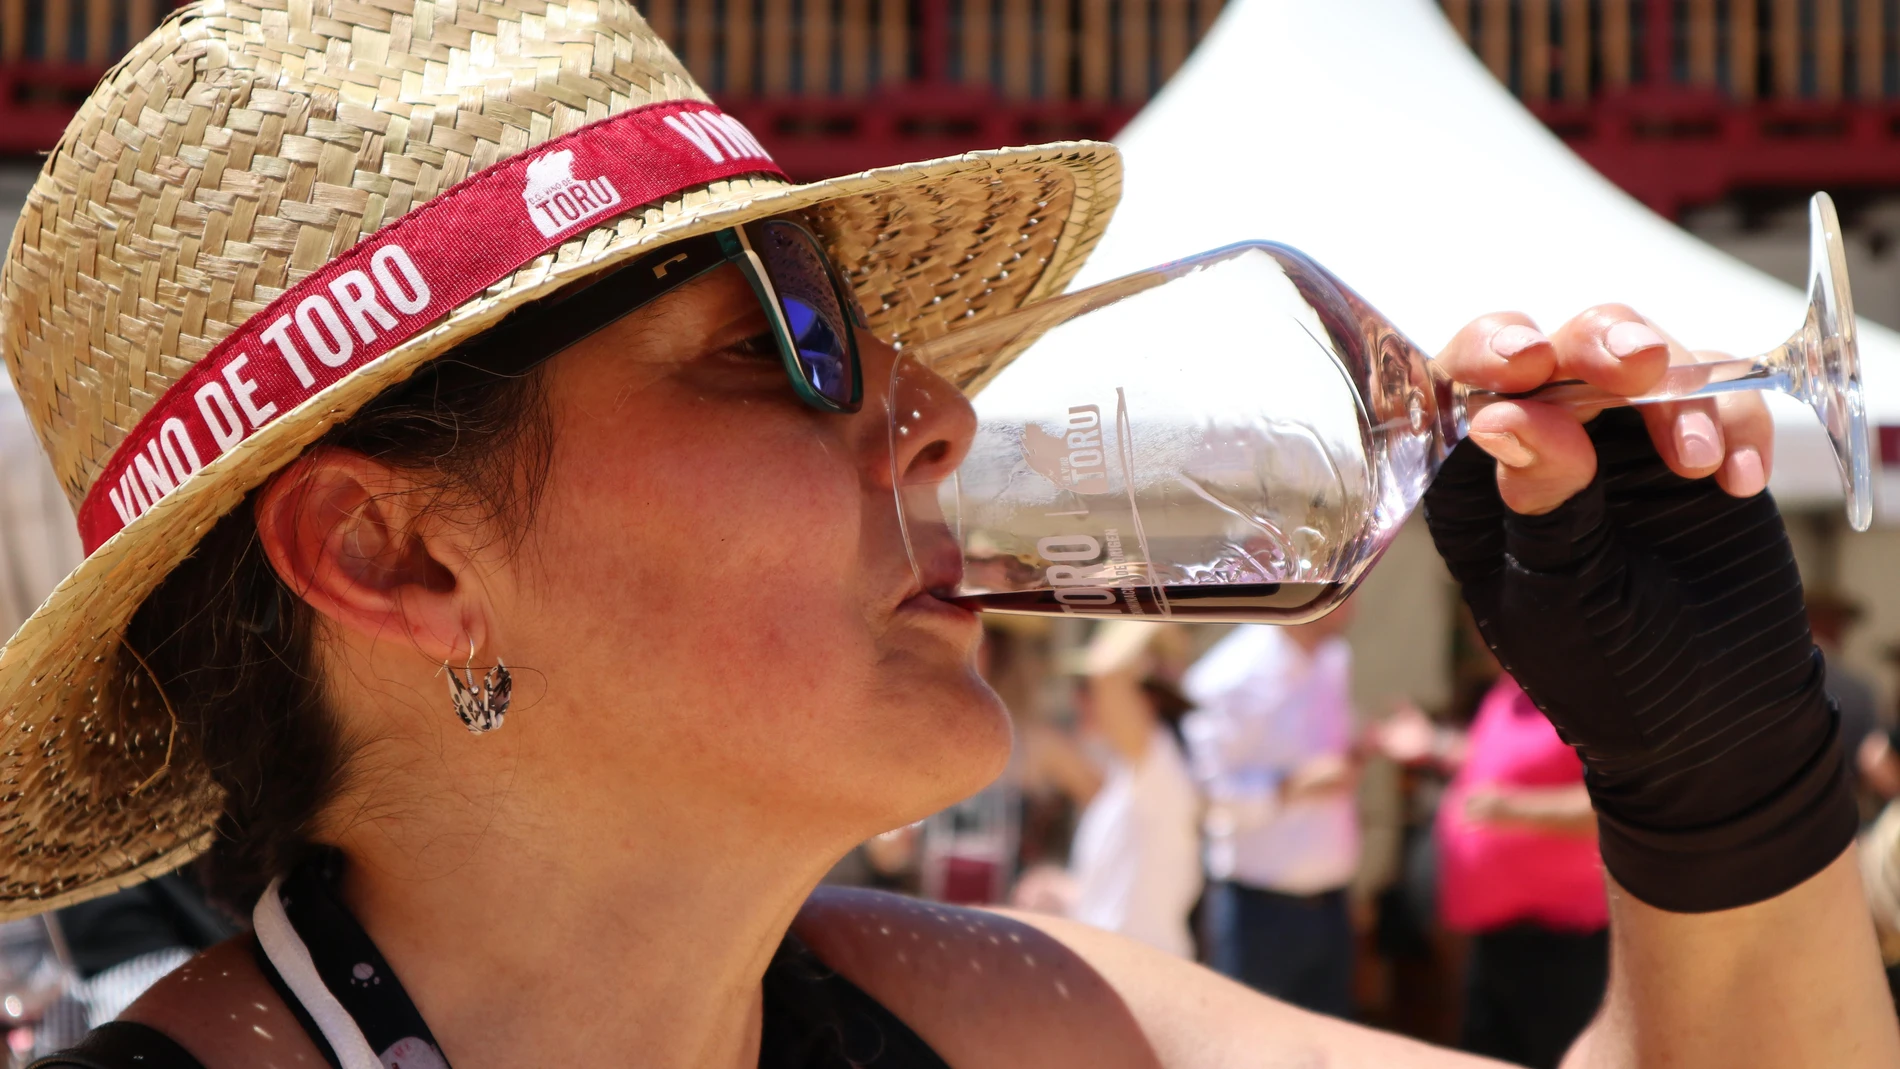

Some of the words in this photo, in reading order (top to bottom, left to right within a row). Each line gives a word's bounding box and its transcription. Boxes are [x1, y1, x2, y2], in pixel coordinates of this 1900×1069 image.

[663, 110, 773, 162] VIN
[562, 177, 573, 187] DE
[109, 417, 201, 526] VINO
[194, 352, 278, 449] DE
[260, 244, 431, 389] TORO
[1104, 529, 1124, 563] ORIGEN
[1114, 565, 1128, 575] DE
